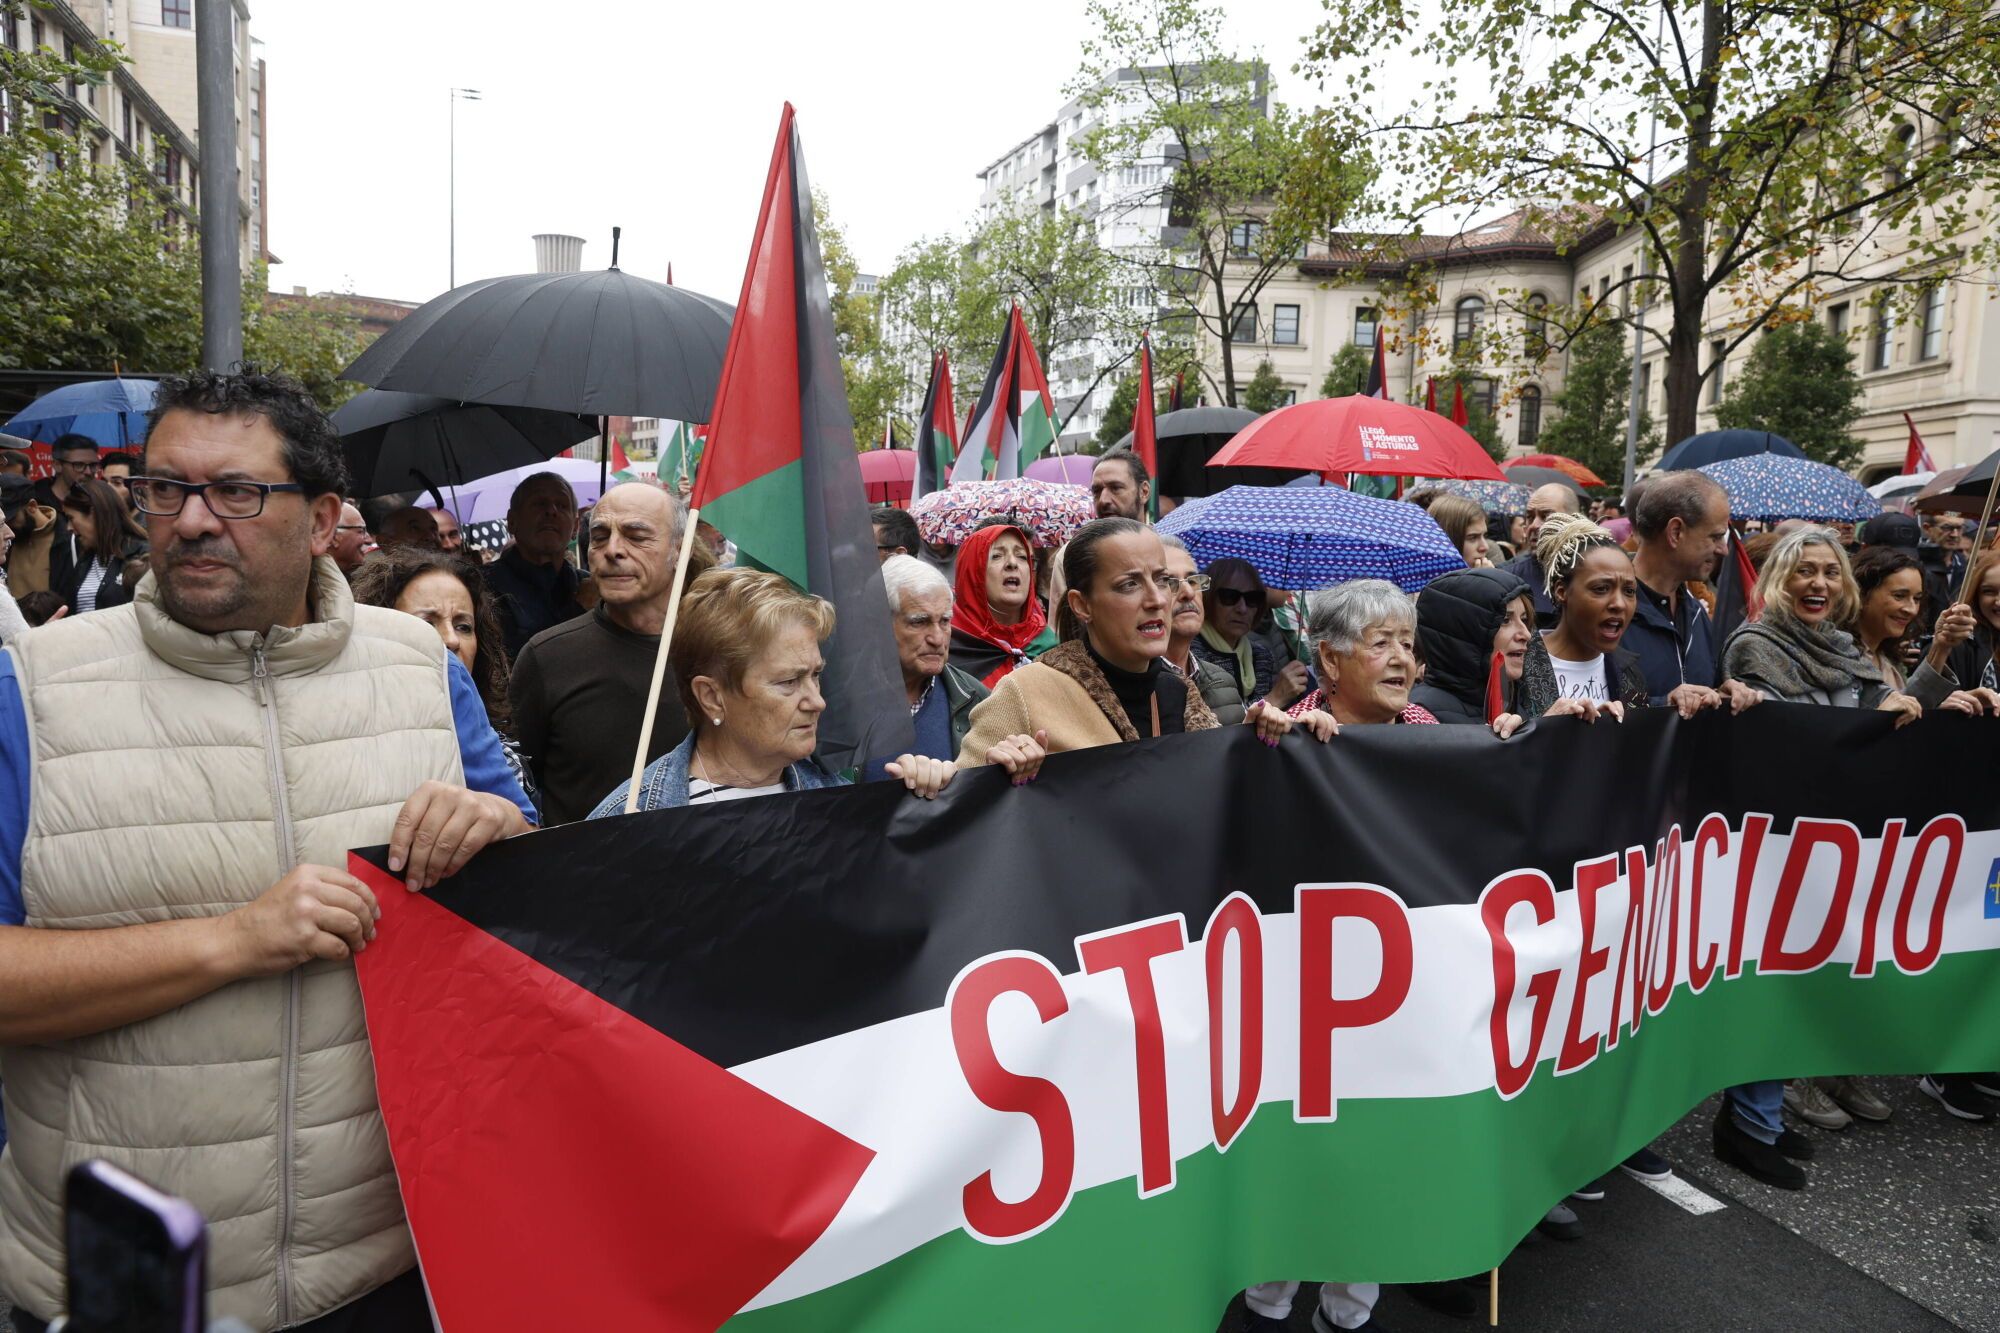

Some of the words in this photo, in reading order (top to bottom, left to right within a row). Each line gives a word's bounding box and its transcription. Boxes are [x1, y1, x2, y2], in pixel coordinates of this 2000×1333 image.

[1359, 425, 1385, 434] LLEGÓ
[1361, 432, 1371, 440] EL
[1372, 434, 1415, 443] MOMENTO
[1362, 440, 1374, 448] DE
[1375, 441, 1419, 450] ASTURIAS
[945, 883, 1414, 1242] STOP
[1479, 813, 1966, 1099] GENOCIDIO
